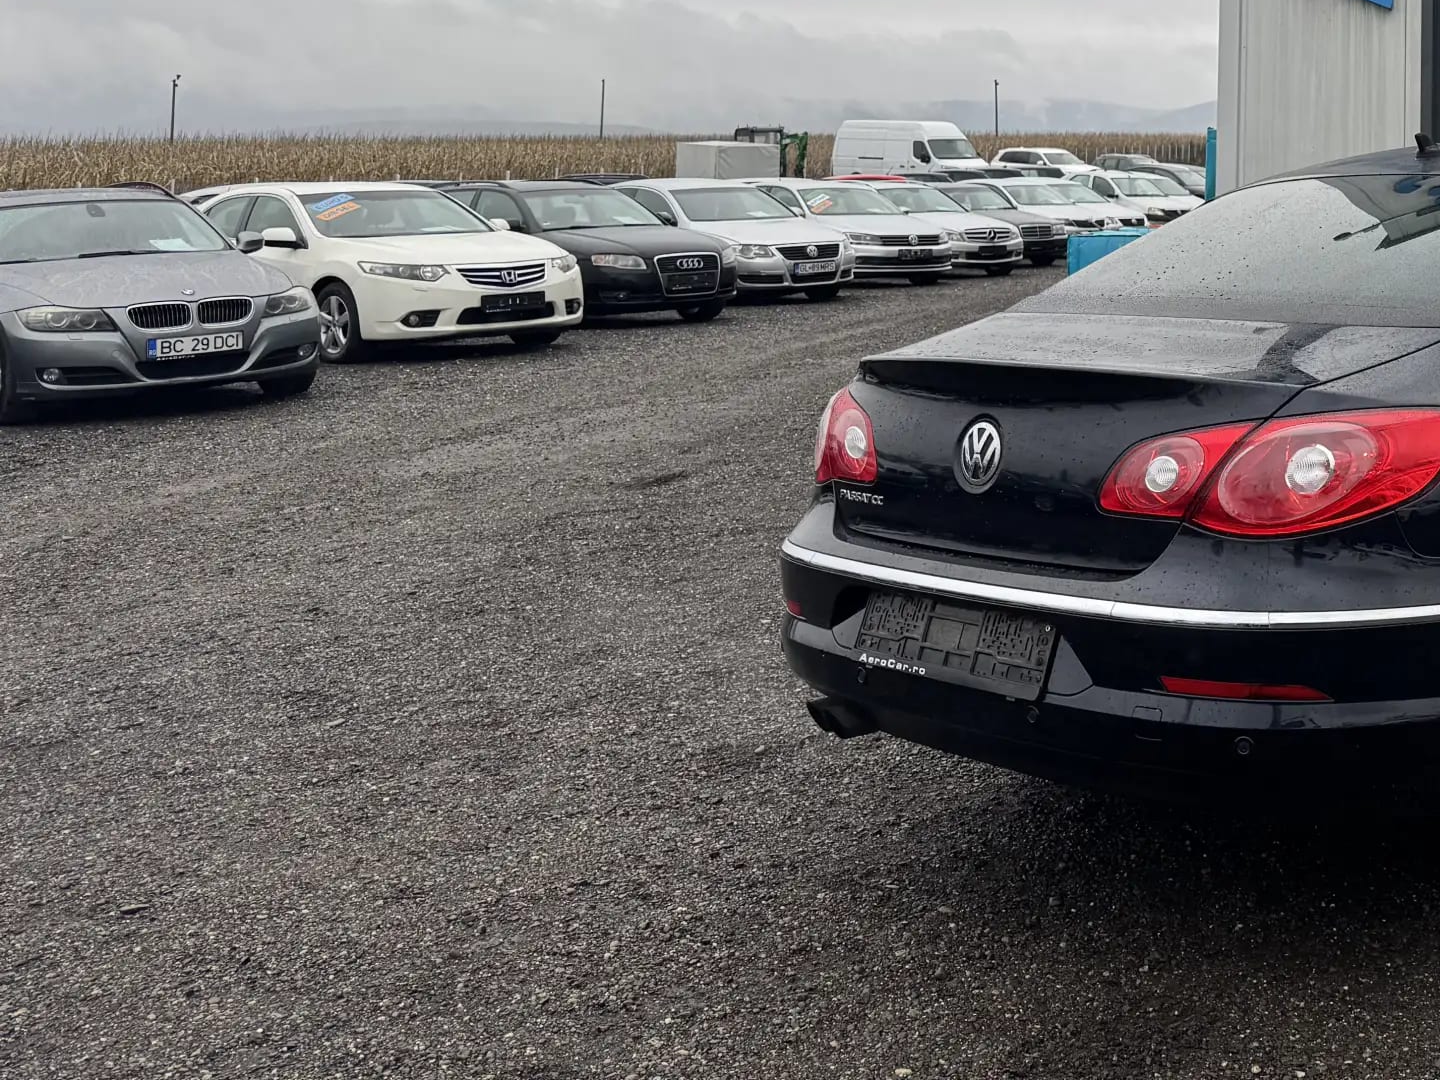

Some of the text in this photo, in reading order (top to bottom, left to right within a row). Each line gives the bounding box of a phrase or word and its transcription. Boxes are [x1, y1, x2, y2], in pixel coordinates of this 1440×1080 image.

[160, 333, 239, 355] BC 29 DCI
[859, 653, 926, 675] AeroCar.ro
